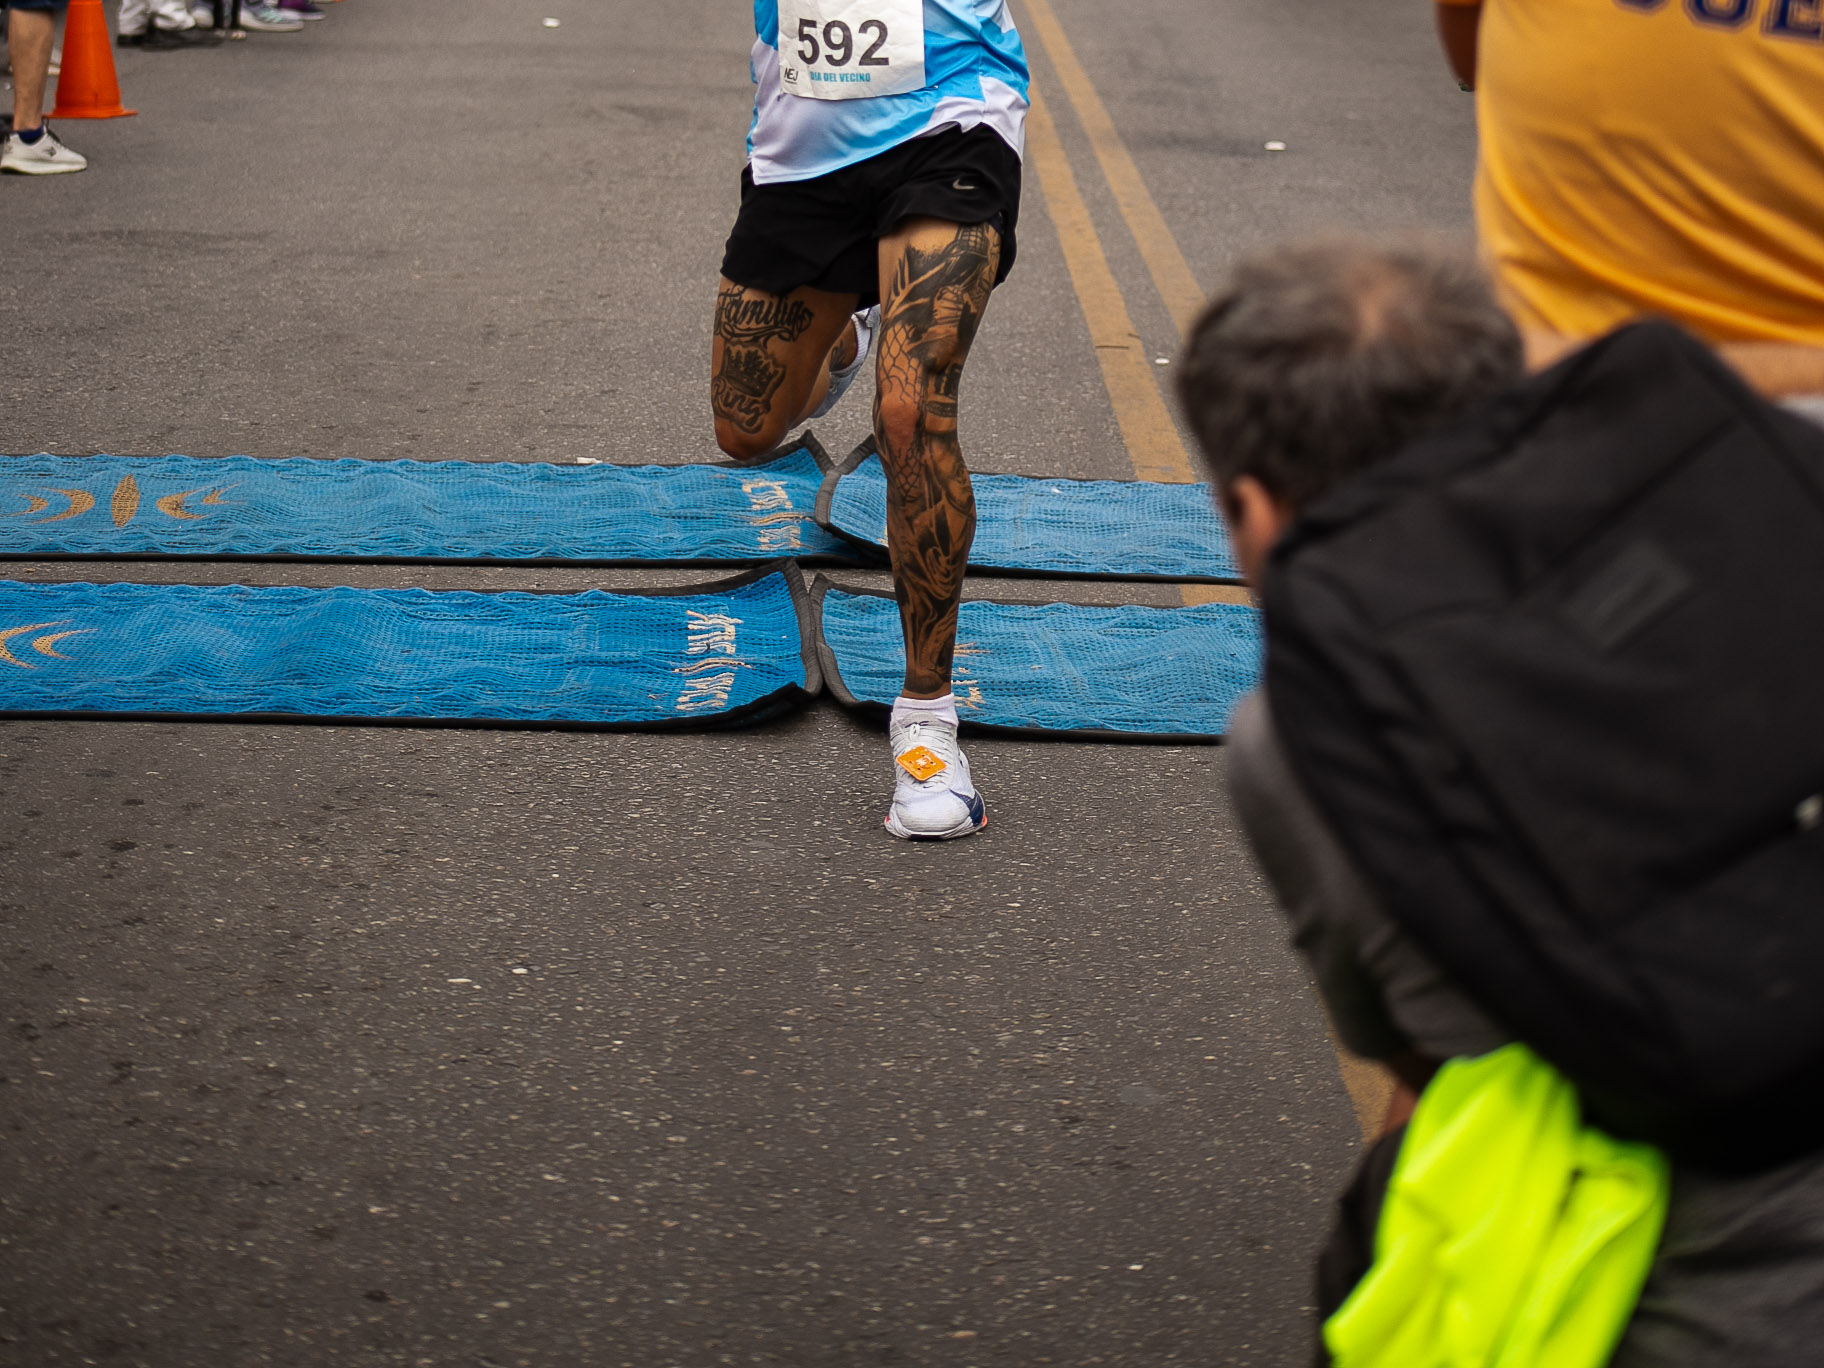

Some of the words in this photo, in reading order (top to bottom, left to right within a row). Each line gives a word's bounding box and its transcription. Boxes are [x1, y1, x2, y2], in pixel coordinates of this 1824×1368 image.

[797, 17, 890, 67] 592
[823, 72, 837, 83] DEL
[839, 72, 871, 83] VECINO
